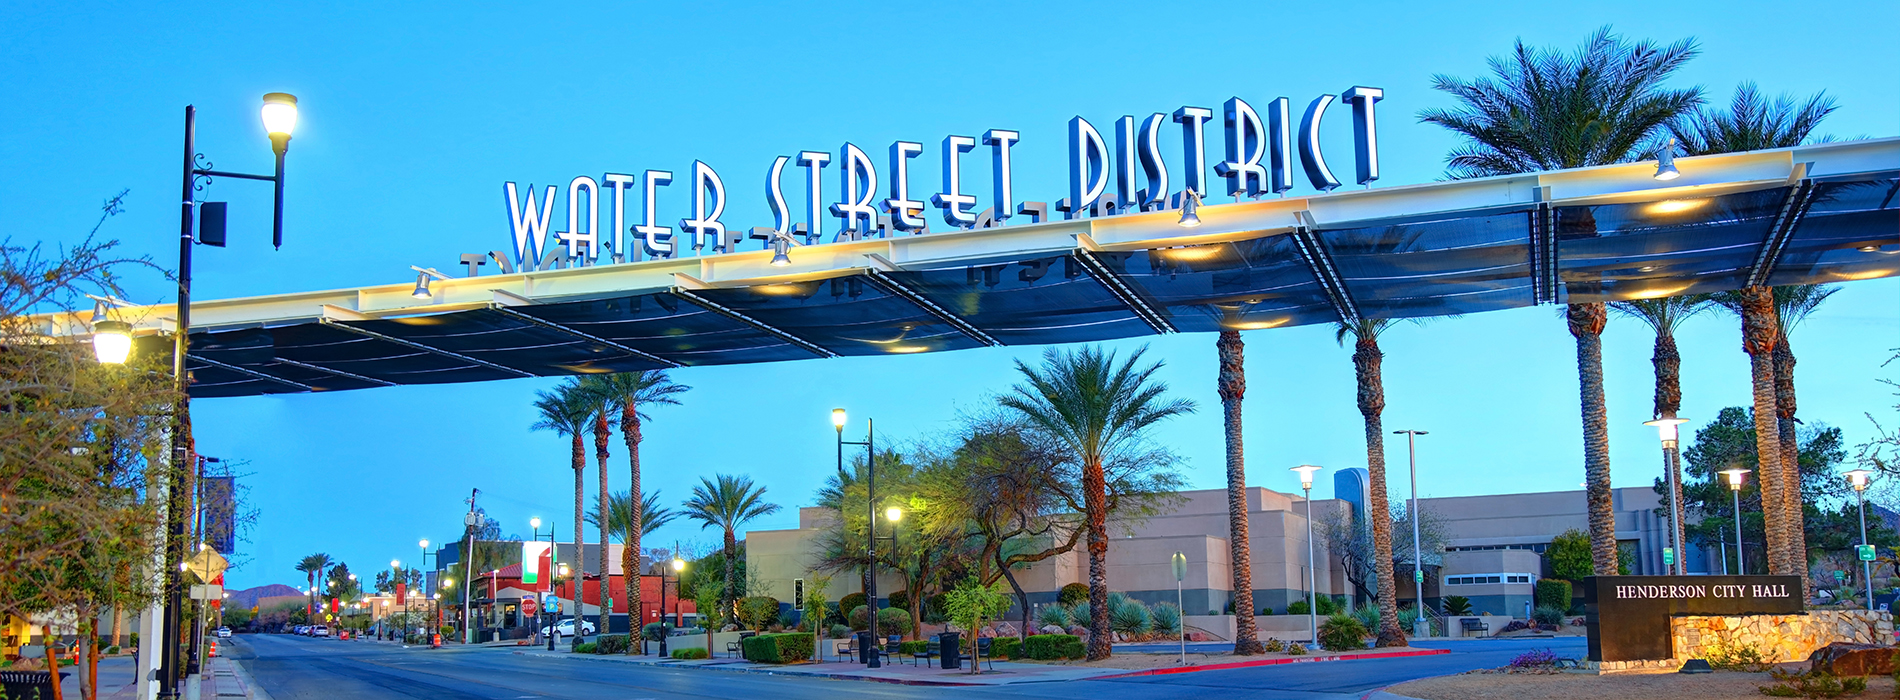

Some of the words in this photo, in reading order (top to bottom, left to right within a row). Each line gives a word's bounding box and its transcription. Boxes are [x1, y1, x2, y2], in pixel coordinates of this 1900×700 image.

[503, 159, 726, 267] WATER
[766, 129, 1020, 239] STREET
[1068, 86, 1384, 214] DISTRICT
[1616, 585, 1706, 599] HENDERSON
[1712, 585, 1746, 598] CITY
[1752, 584, 1790, 598] HALL
